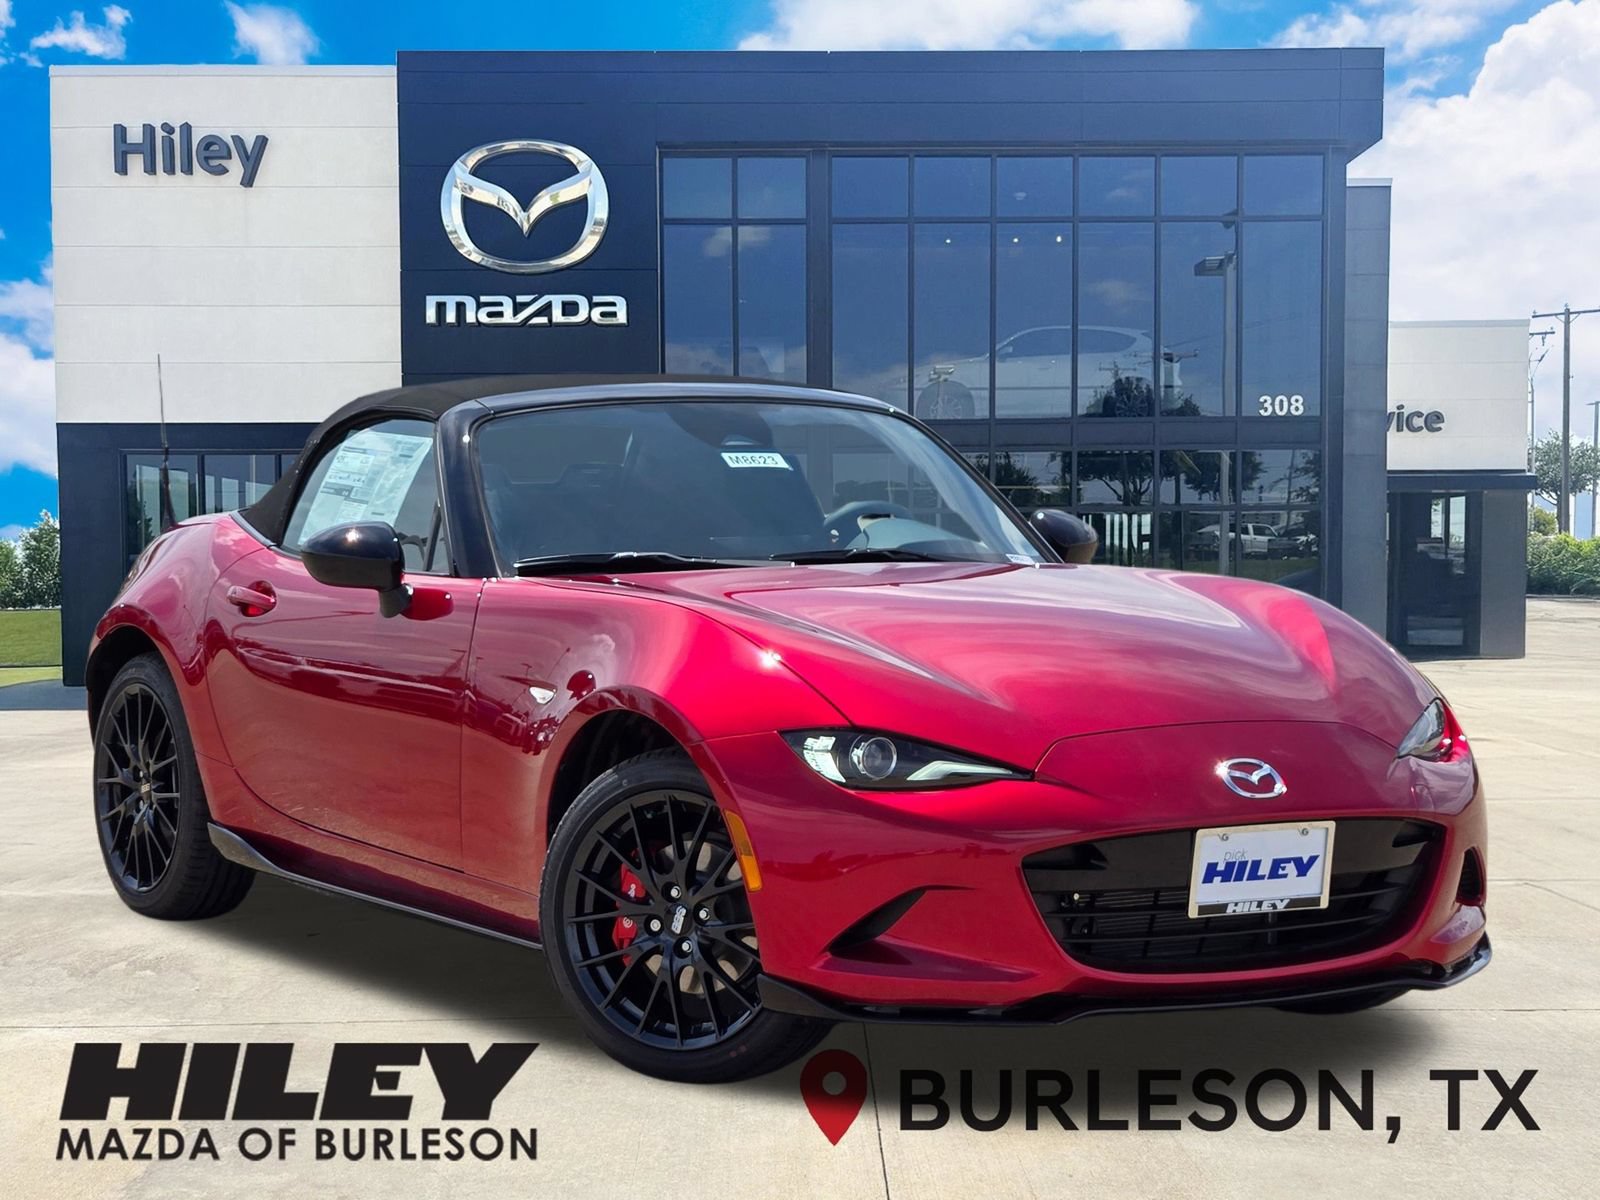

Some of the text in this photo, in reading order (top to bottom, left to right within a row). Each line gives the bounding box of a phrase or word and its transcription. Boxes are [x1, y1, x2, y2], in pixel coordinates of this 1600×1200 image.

[113, 121, 269, 188] Hiley
[425, 294, 628, 326] mazda
[1258, 395, 1304, 416] 308
[727, 455, 779, 465] M8623
[1202, 854, 1320, 884] HILEY
[1226, 898, 1290, 914] HILEY
